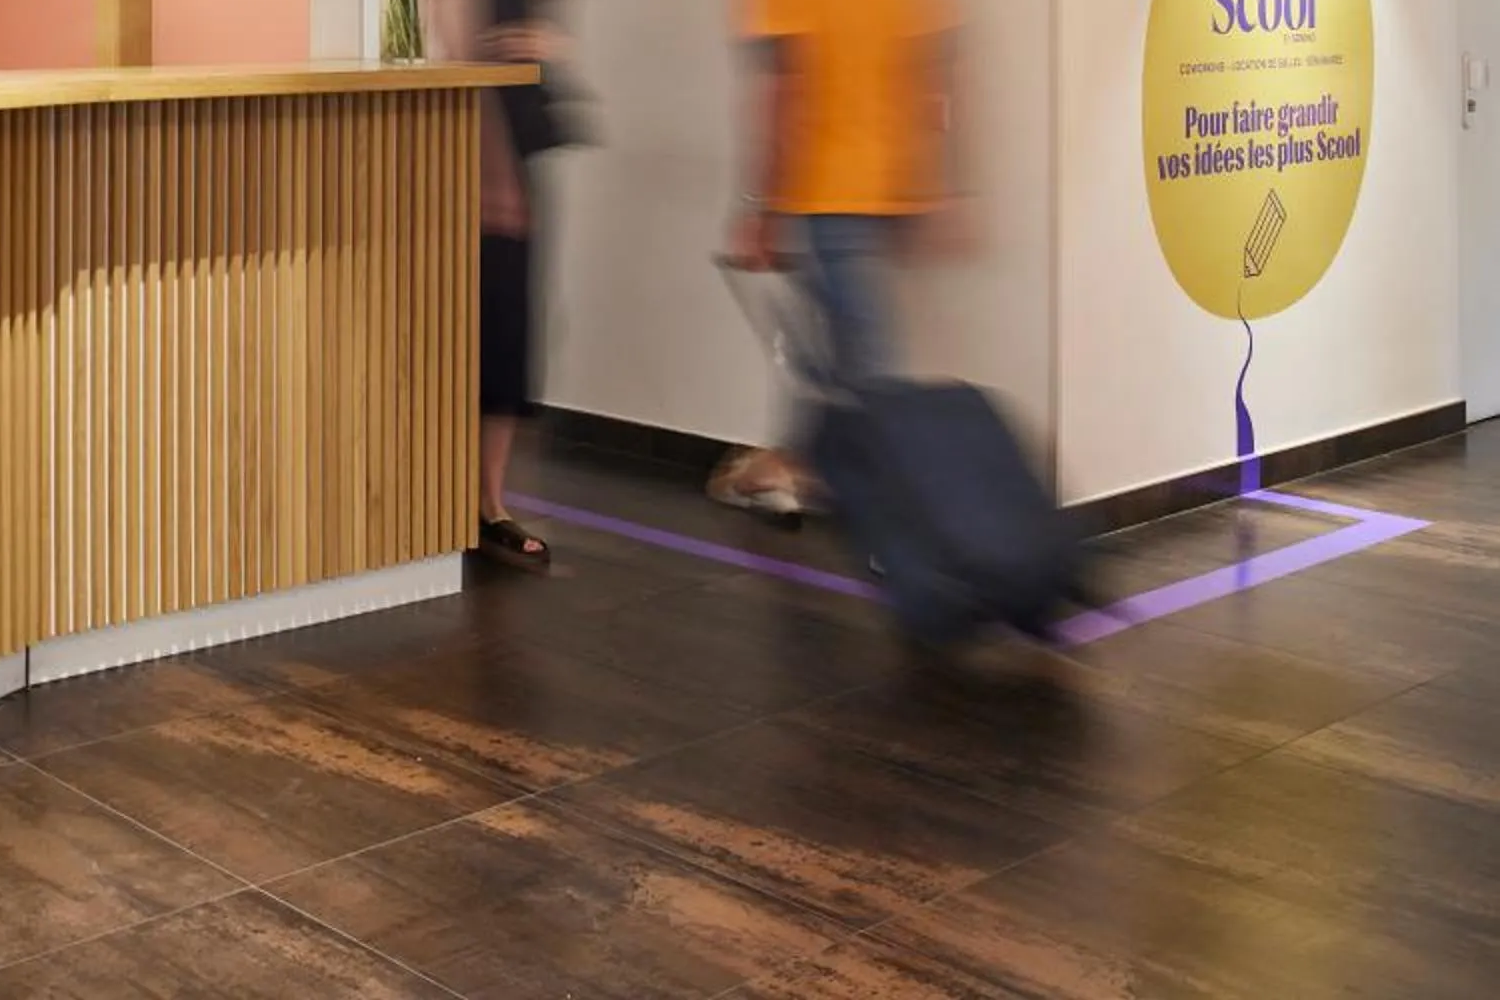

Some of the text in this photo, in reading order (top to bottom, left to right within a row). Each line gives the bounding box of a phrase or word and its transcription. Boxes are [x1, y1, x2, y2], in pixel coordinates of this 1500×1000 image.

[1185, 94, 1339, 139] Pour faire grandir
[1157, 127, 1362, 181] vos idées les plus Scool
